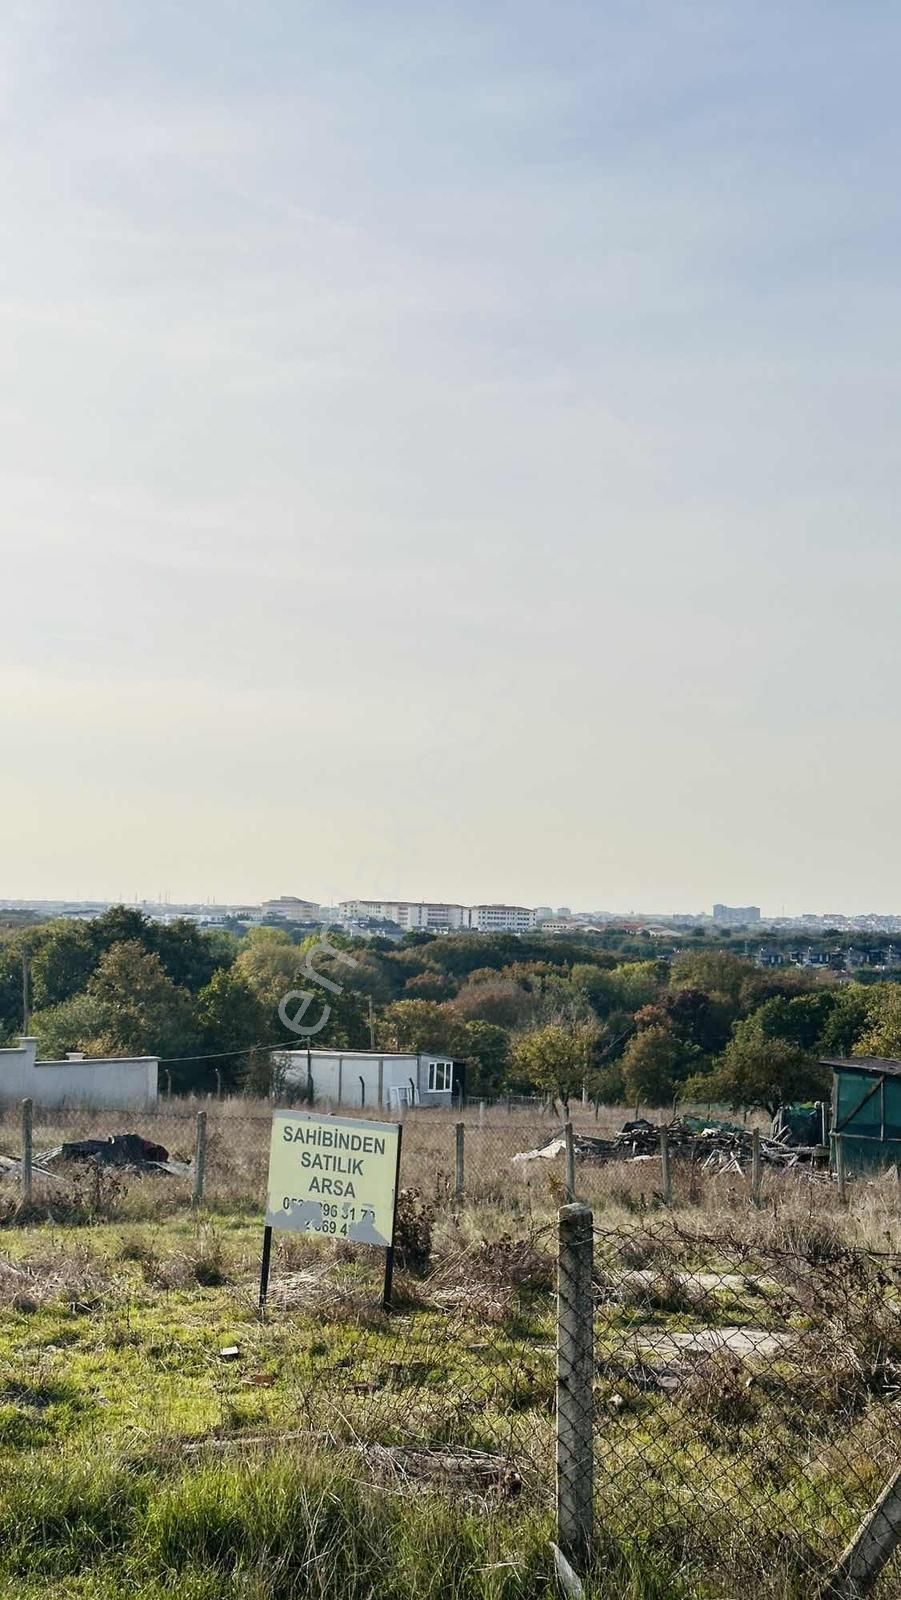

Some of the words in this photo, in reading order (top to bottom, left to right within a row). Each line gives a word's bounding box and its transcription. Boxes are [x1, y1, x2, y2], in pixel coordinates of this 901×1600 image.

[283, 1126, 386, 1154] SAHİBİNDEN
[301, 1152, 364, 1176] SATILIK
[308, 1177, 356, 1198] ARSA
